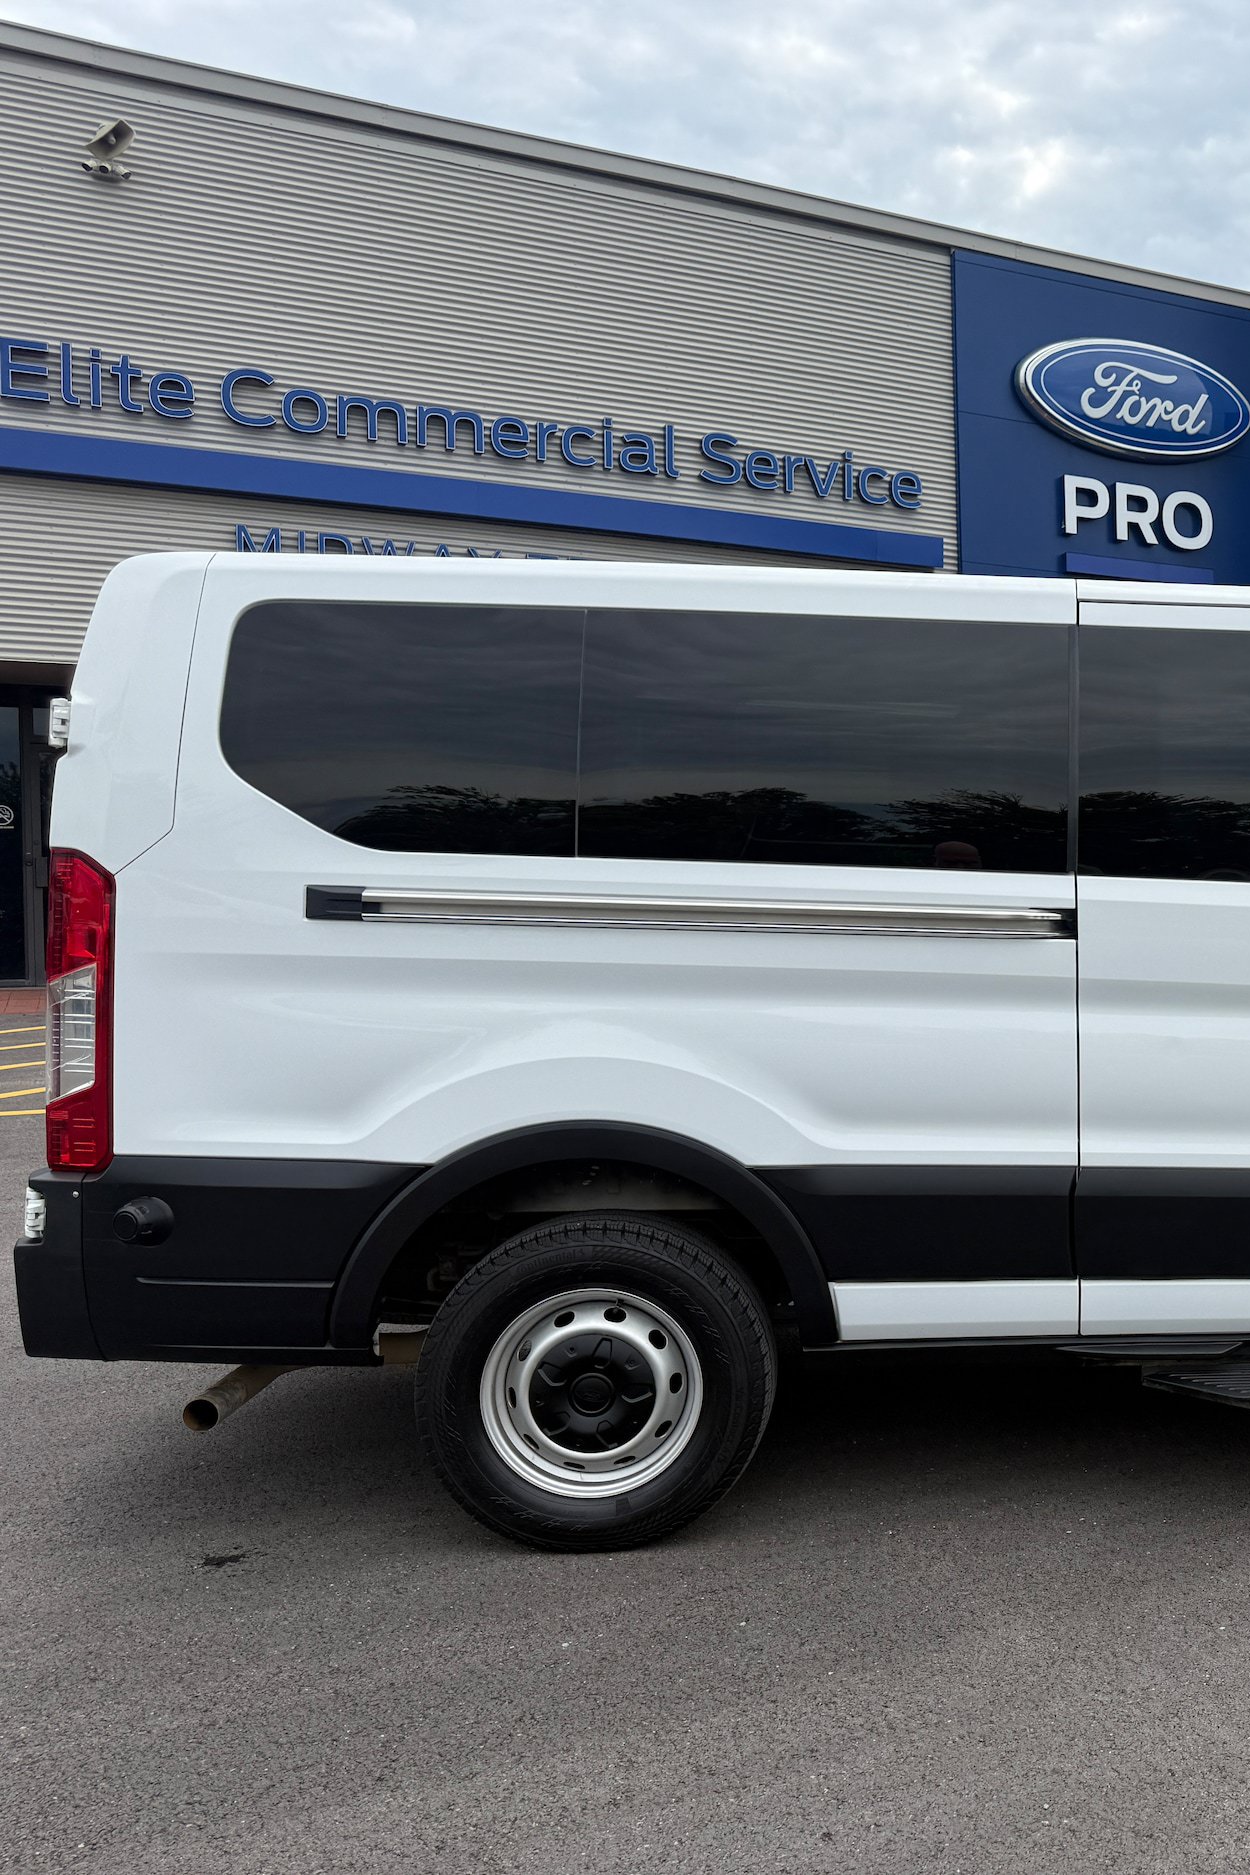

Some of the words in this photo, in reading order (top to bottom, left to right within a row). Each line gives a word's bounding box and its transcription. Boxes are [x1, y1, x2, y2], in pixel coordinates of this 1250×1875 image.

[0, 338, 196, 419] Elite
[220, 368, 680, 478] Commercial
[700, 432, 923, 510] Service
[1080, 361, 1210, 436] Ford
[1063, 473, 1214, 551] PRO
